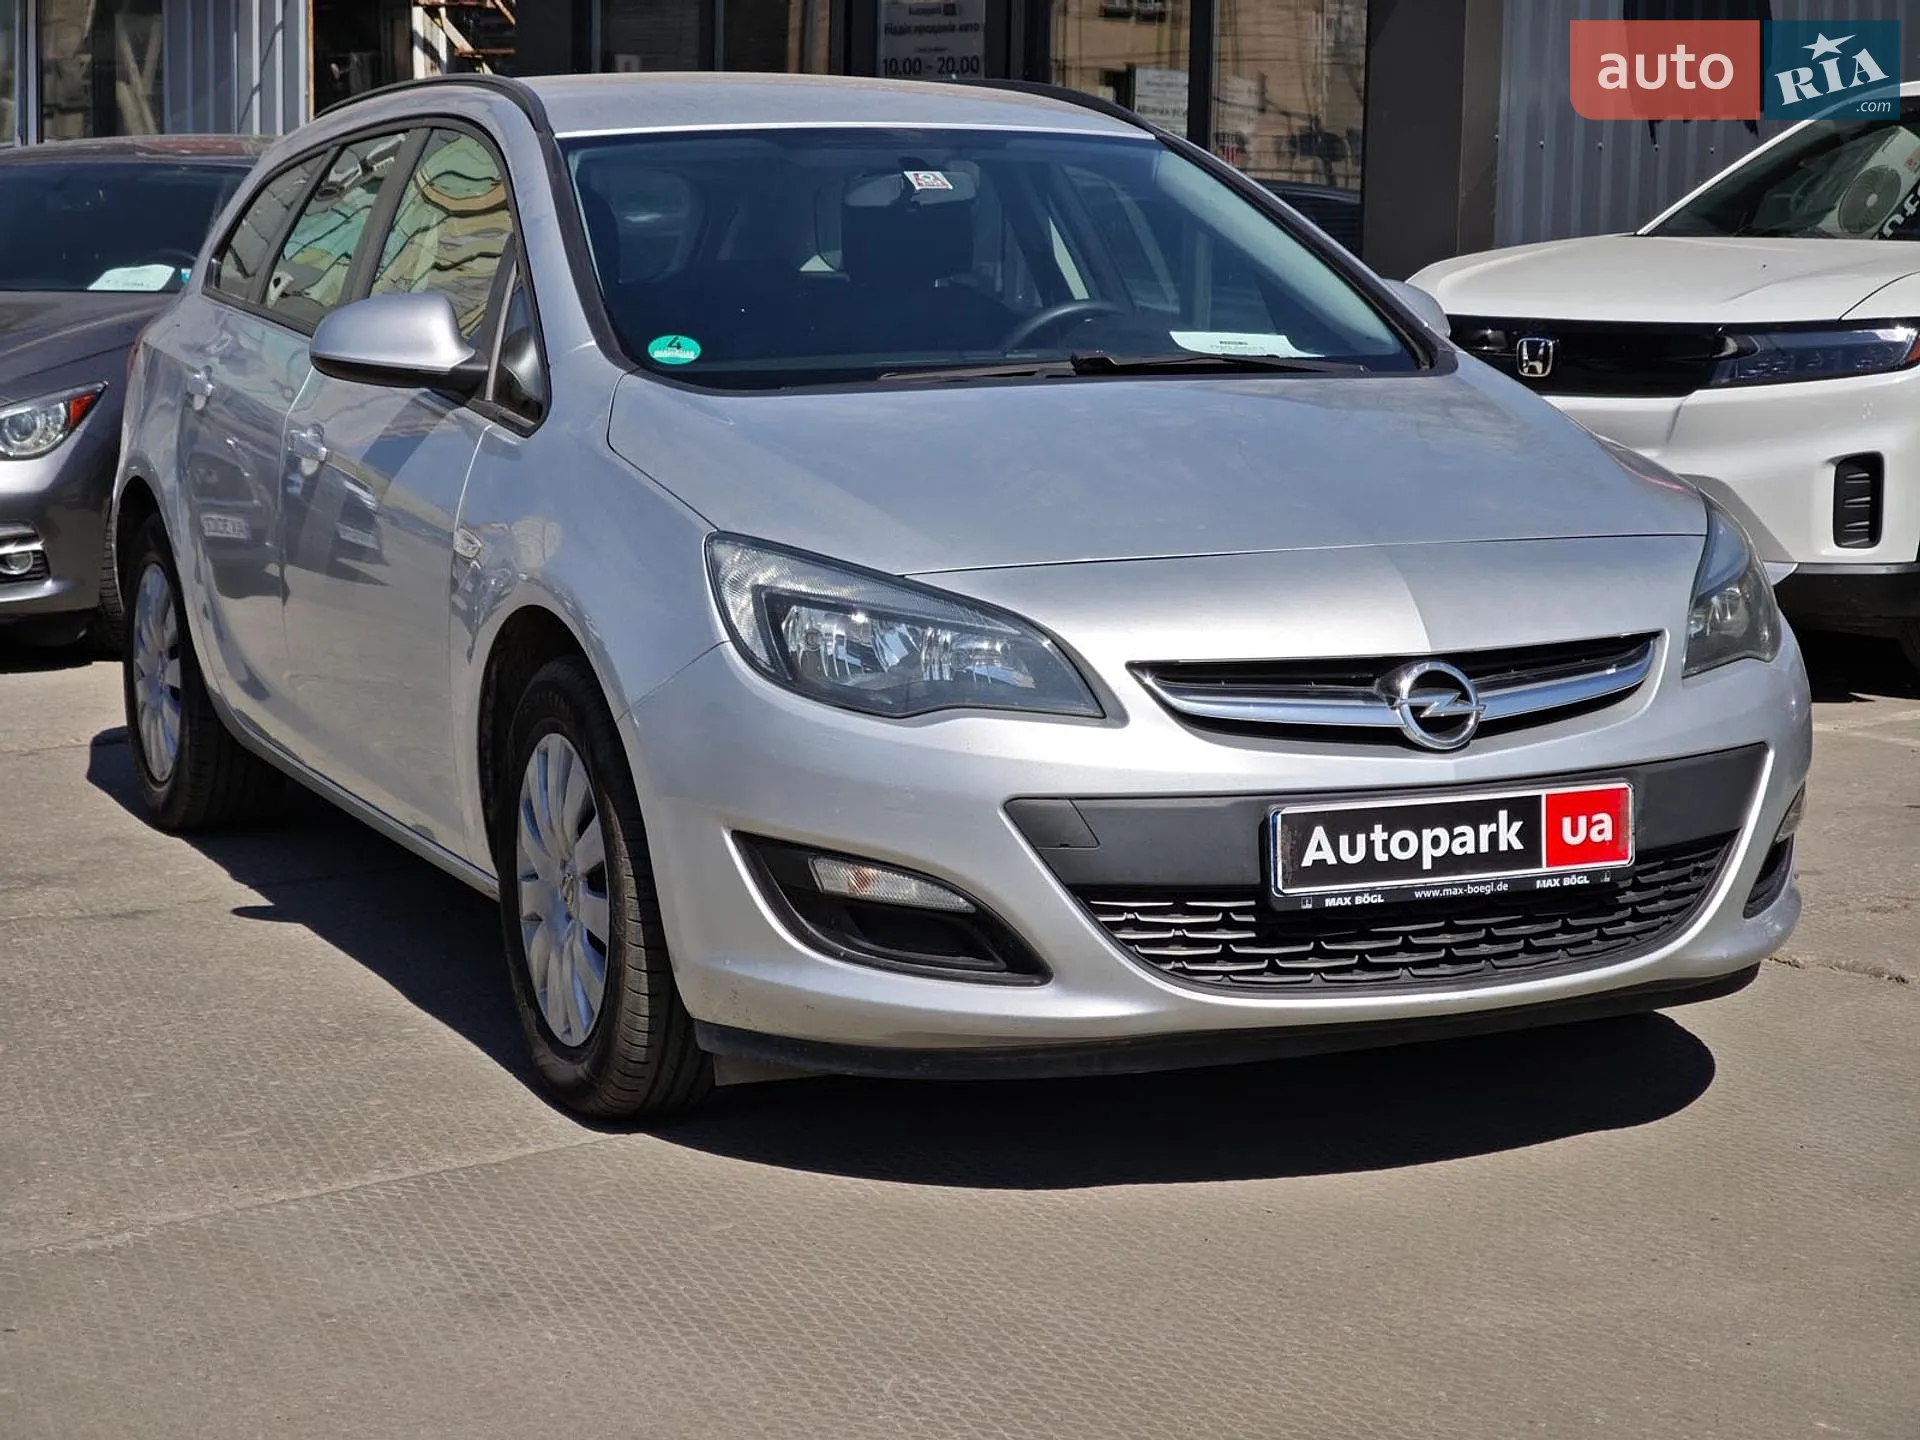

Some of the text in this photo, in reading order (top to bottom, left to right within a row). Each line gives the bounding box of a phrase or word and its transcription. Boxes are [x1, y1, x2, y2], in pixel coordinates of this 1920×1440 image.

[667, 336, 682, 350] 4
[1301, 809, 1613, 870] Autopark ua
[1325, 874, 1590, 908] MAX BÖGL www.max-boegl.de MAX BÖGL
